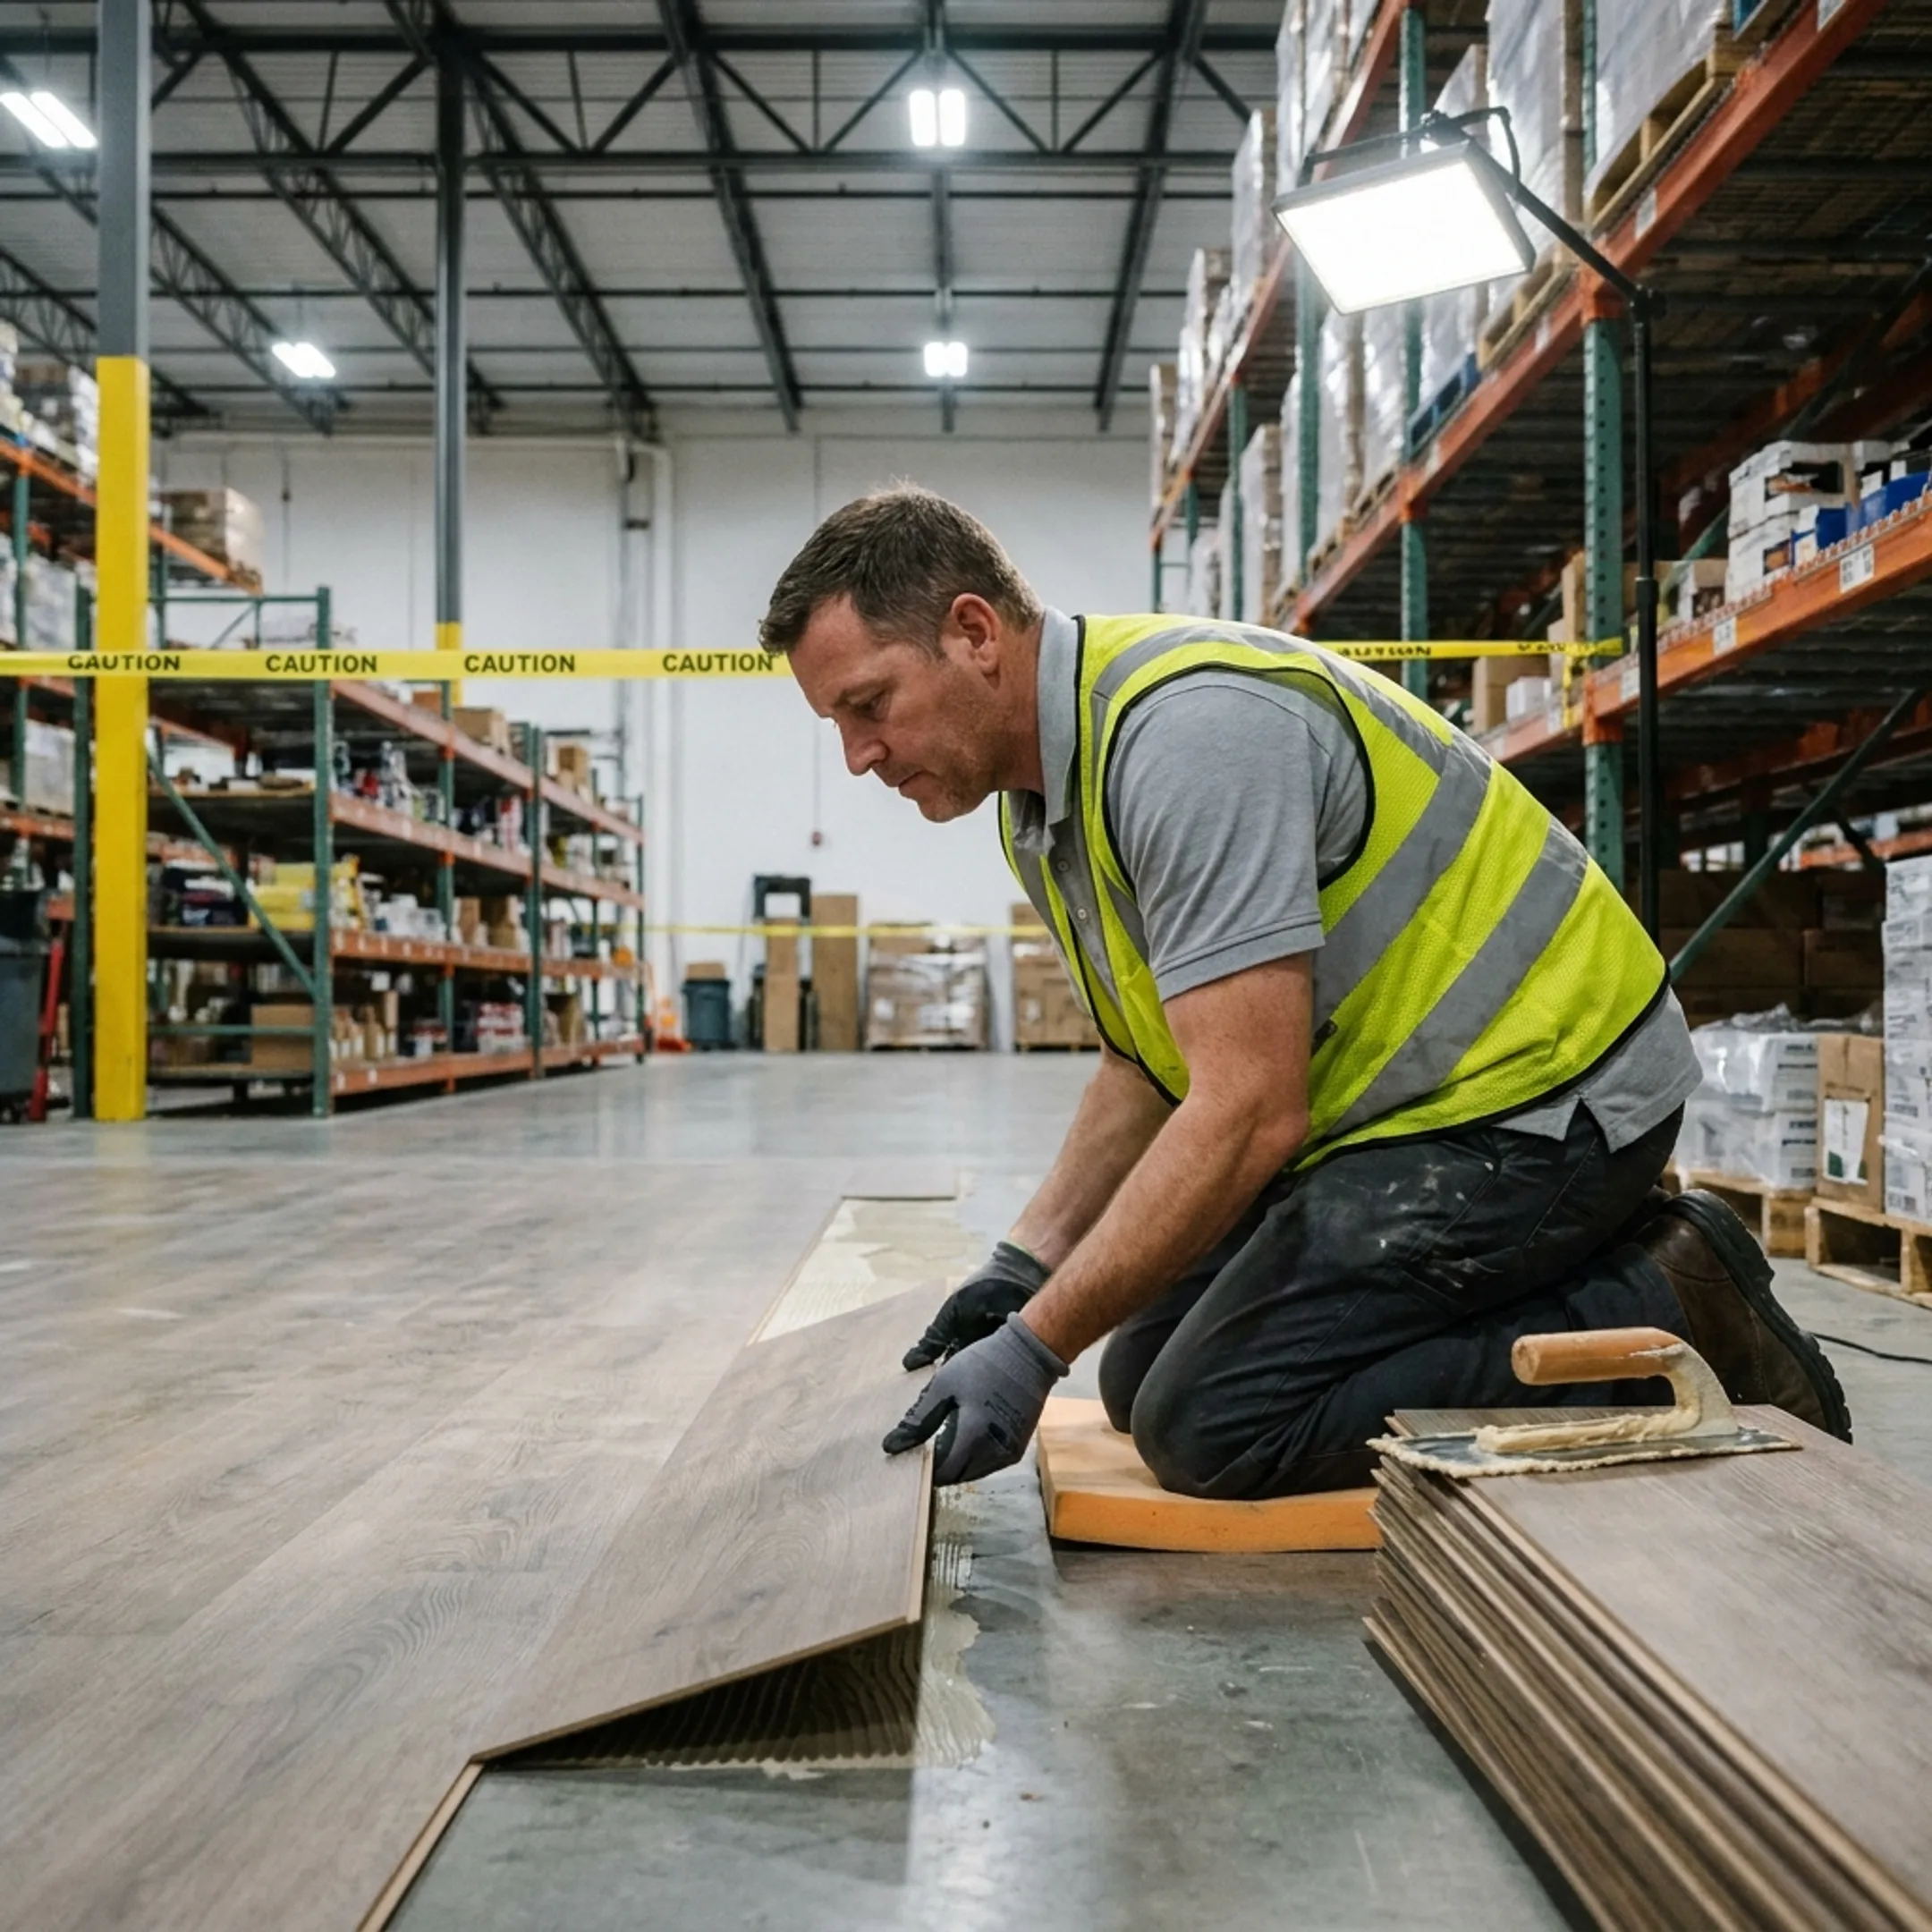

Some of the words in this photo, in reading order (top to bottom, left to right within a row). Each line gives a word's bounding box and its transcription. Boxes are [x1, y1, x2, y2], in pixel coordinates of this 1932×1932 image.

[67, 654, 180, 671] CAUTION
[265, 654, 377, 673] CAUTION
[464, 654, 576, 673] CAUTION
[662, 653, 774, 672] CAUTION
